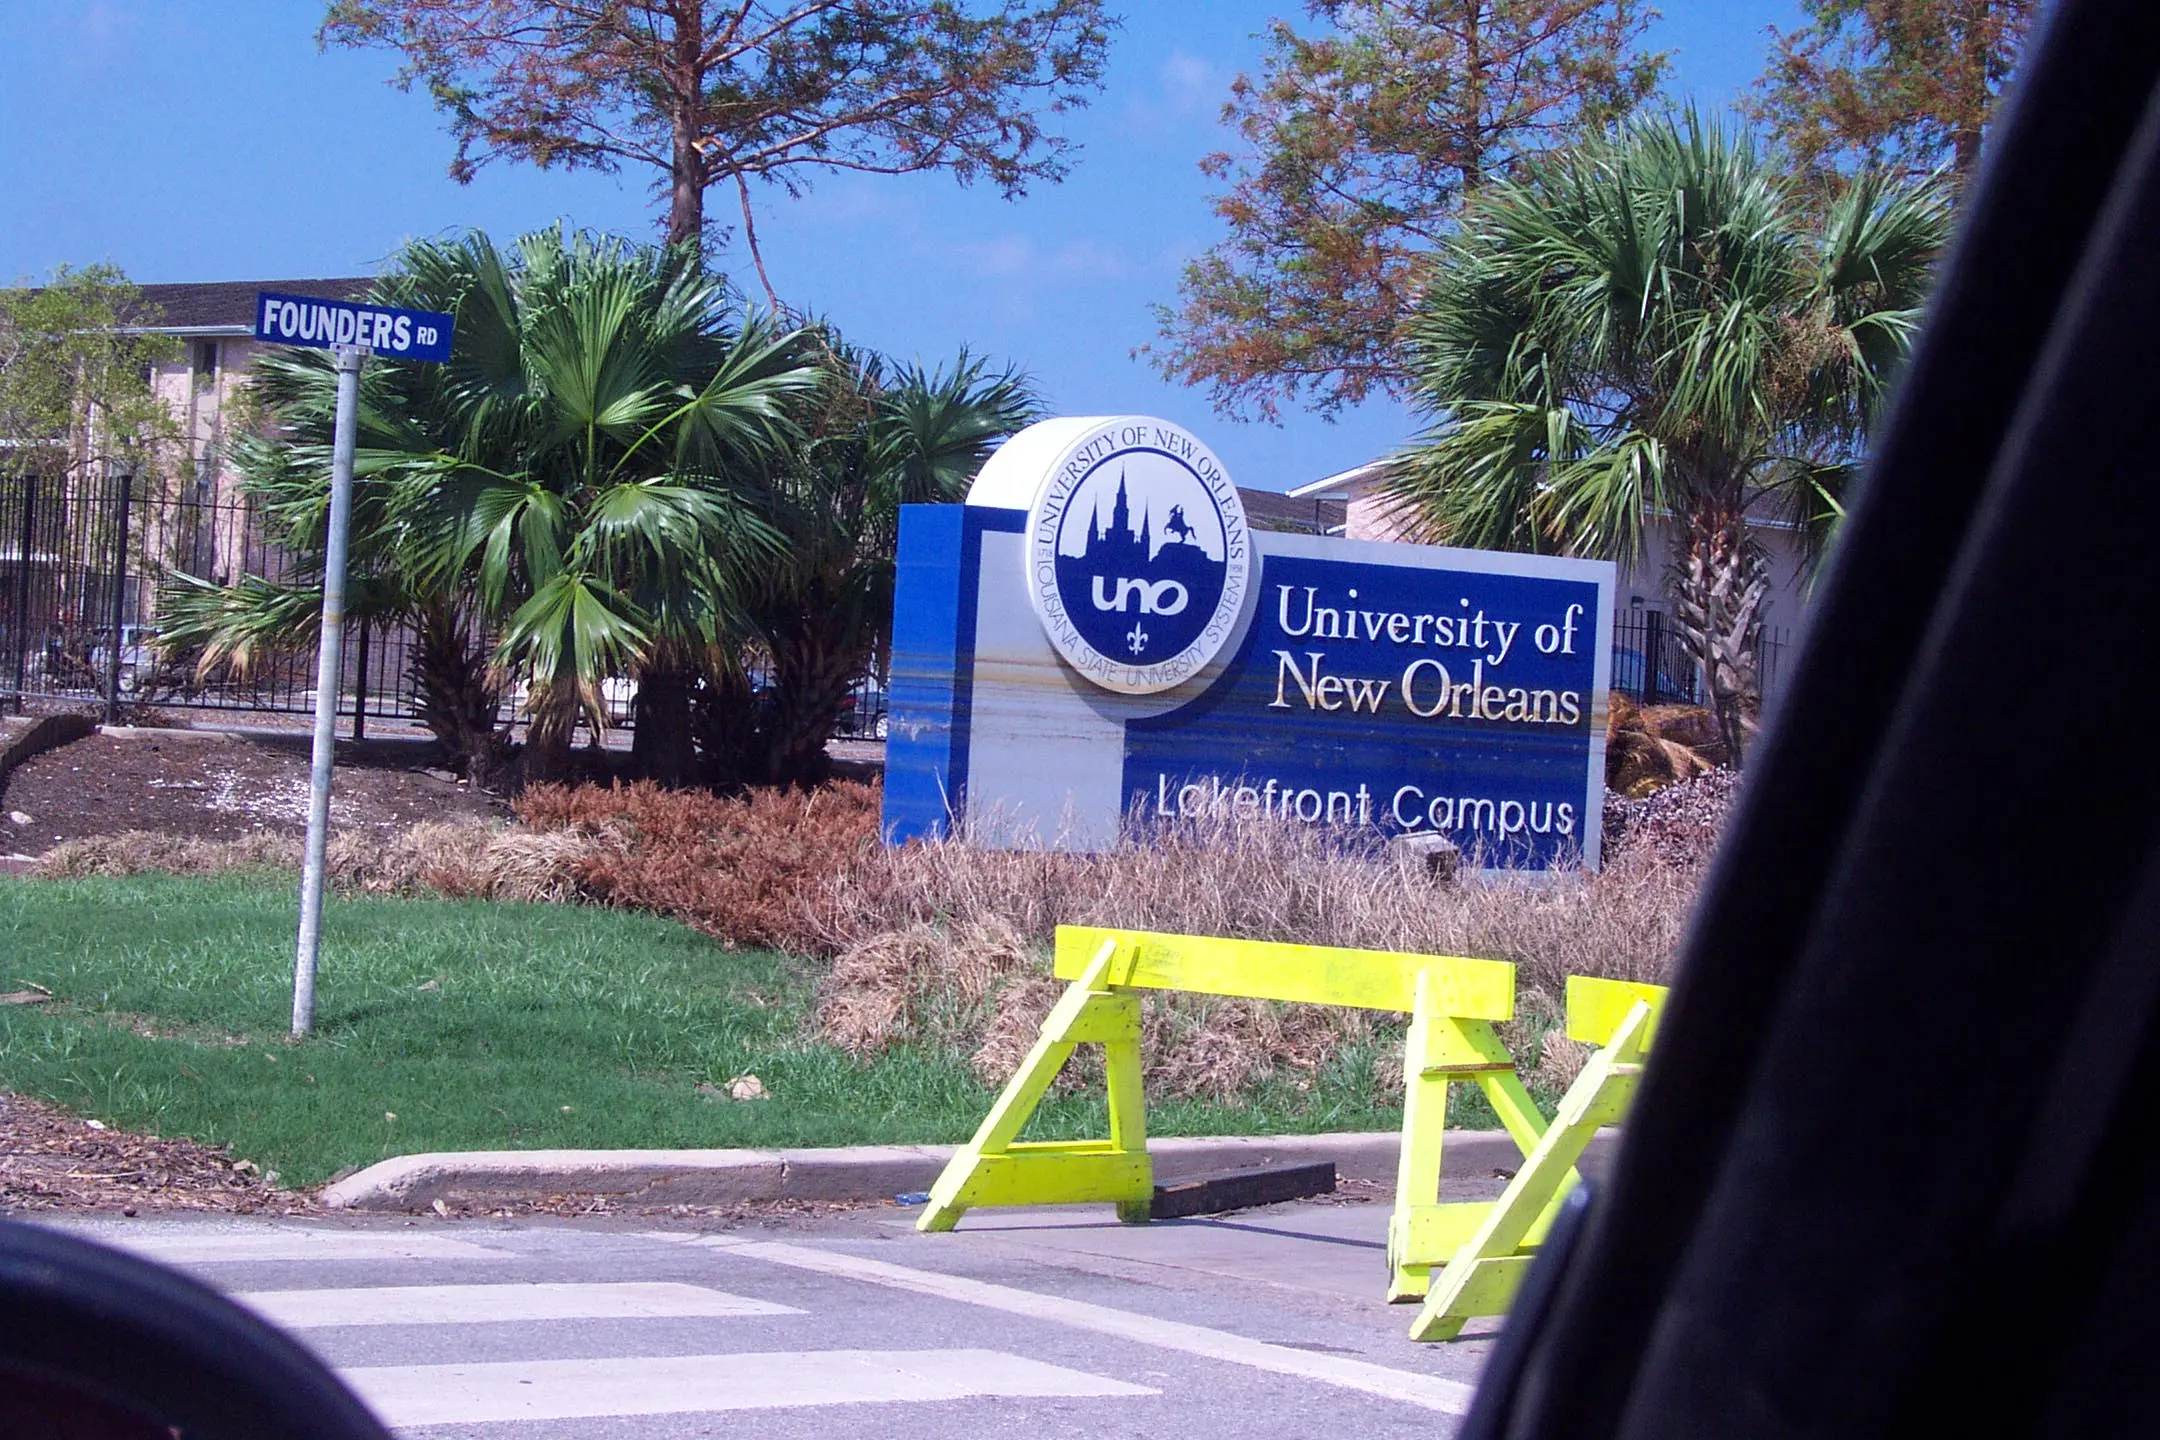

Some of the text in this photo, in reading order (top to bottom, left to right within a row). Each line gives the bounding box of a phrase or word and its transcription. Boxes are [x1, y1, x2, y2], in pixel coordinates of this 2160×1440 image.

[263, 299, 438, 351] FOUNDERS RD
[1038, 426, 1244, 559] UNIVERSITY OF NEW ORLEANS
[1037, 560, 1242, 686] LOUISIANA STATE UNIVERSITY SYSTEM
[1091, 575, 1188, 616] uno
[1276, 584, 1583, 666] University of
[1268, 649, 1581, 725] New Orleans
[1158, 772, 1575, 840] Lakefront Campus
